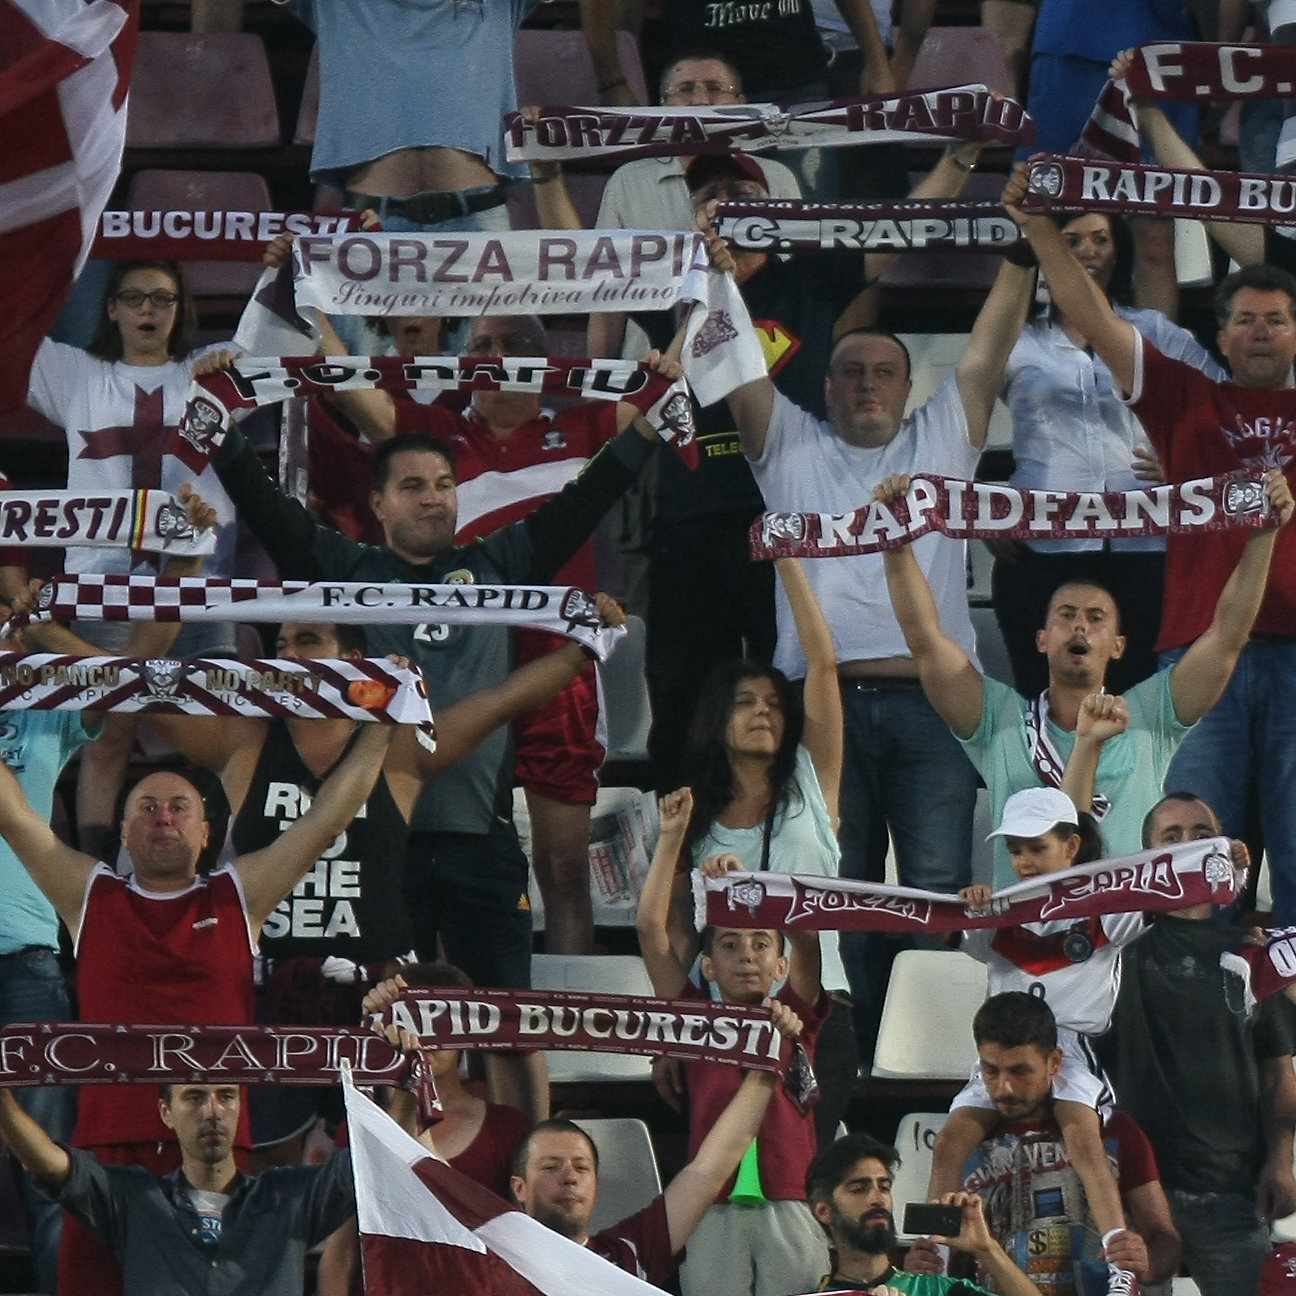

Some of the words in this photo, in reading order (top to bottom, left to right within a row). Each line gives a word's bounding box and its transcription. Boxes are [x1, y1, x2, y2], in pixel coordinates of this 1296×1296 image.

[1081, 165, 1222, 210] RAPID
[820, 217, 1022, 250] RAPID
[302, 239, 523, 287] FORZA
[818, 476, 1215, 549] RAPIDFANS
[321, 585, 396, 609] F.C.
[406, 586, 551, 611] RAPID
[261, 900, 362, 939] SEA
[147, 1032, 408, 1072] RAPID
